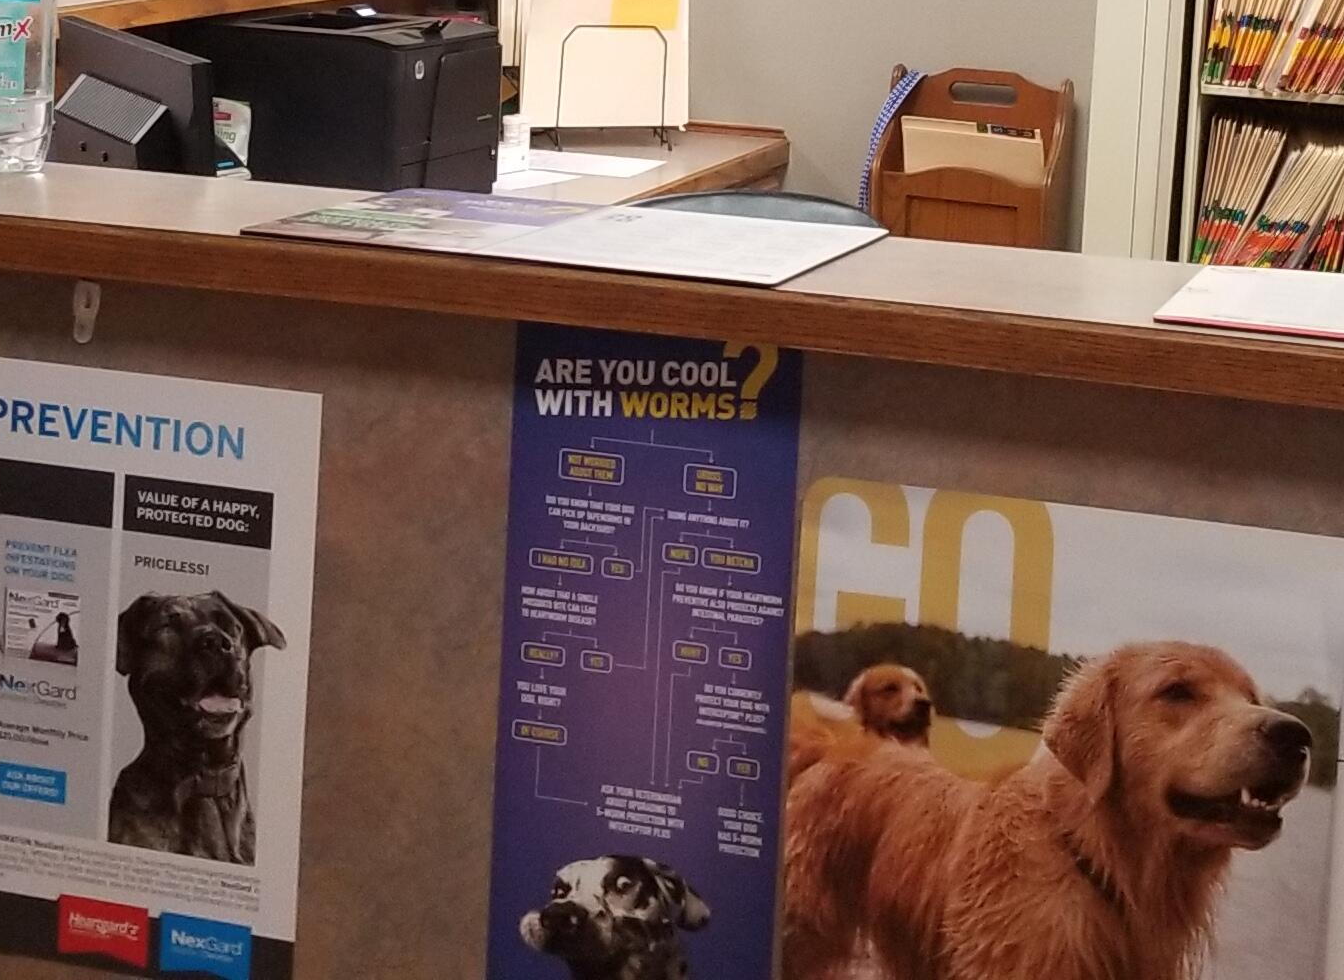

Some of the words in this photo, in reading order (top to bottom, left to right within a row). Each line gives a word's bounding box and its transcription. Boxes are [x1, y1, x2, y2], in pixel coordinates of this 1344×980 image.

[534, 358, 593, 385] ARE
[598, 359, 656, 386] YOU
[661, 361, 737, 388] COOL
[534, 389, 613, 418] WITH
[137, 490, 179, 508] VALUE
[181, 496, 199, 510] OF
[200, 498, 211, 511] A
[213, 500, 261, 519] HAPPY,
[136, 507, 213, 529] PROTECTED
[216, 517, 249, 533] DOG:
[5, 539, 51, 555] PREVENT
[53, 545, 78, 558] FLEA
[134, 555, 210, 576] PRICELESS!
[170, 929, 243, 956] NexGard
